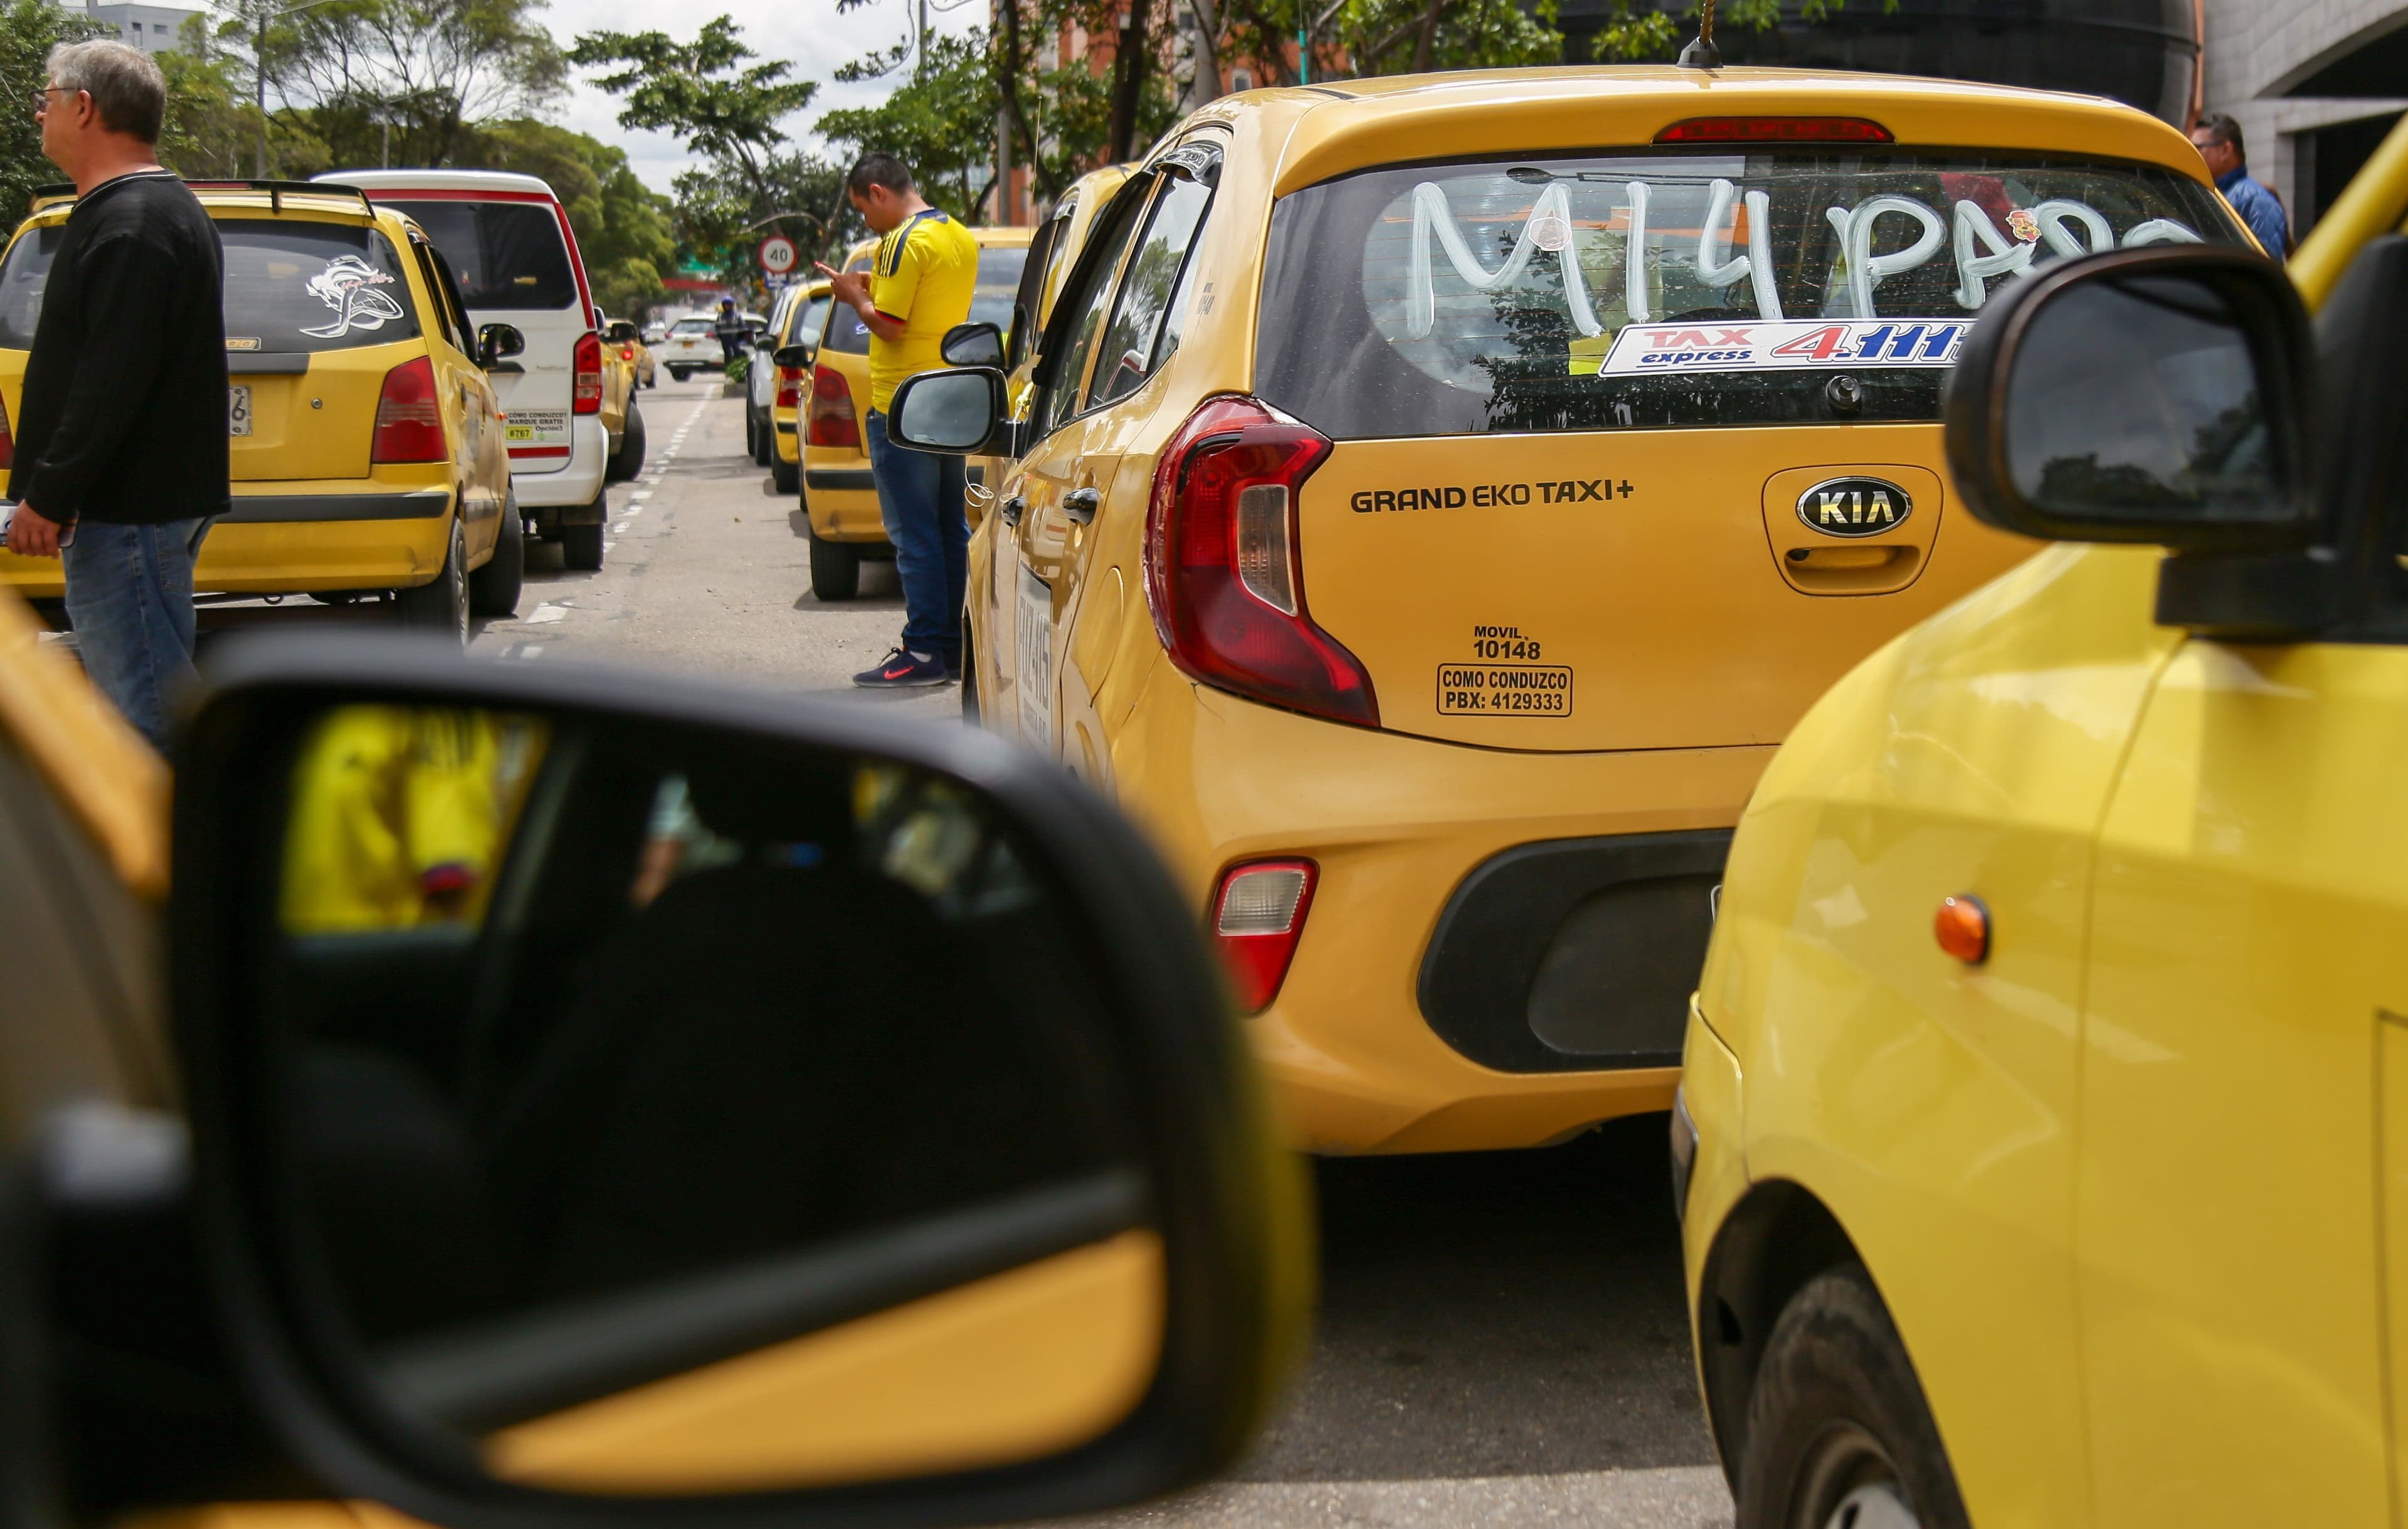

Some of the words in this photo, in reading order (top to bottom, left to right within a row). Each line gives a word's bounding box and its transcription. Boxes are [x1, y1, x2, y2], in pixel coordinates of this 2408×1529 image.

[770, 248, 788, 263] 40
[1644, 329, 1754, 348] TAX
[1641, 350, 1753, 364] express
[510, 429, 530, 437] #767
[1350, 487, 1466, 513] GRAND
[1472, 483, 1532, 507] EKO
[1536, 479, 1634, 504] TAXI+
[1819, 491, 1895, 524] KIA
[1474, 639, 1541, 660] 10148
[1442, 670, 1485, 688] COMO
[1489, 671, 1567, 690] CONDUZCO
[1445, 691, 1486, 709] PBX:
[1491, 692, 1563, 710] 4129333
